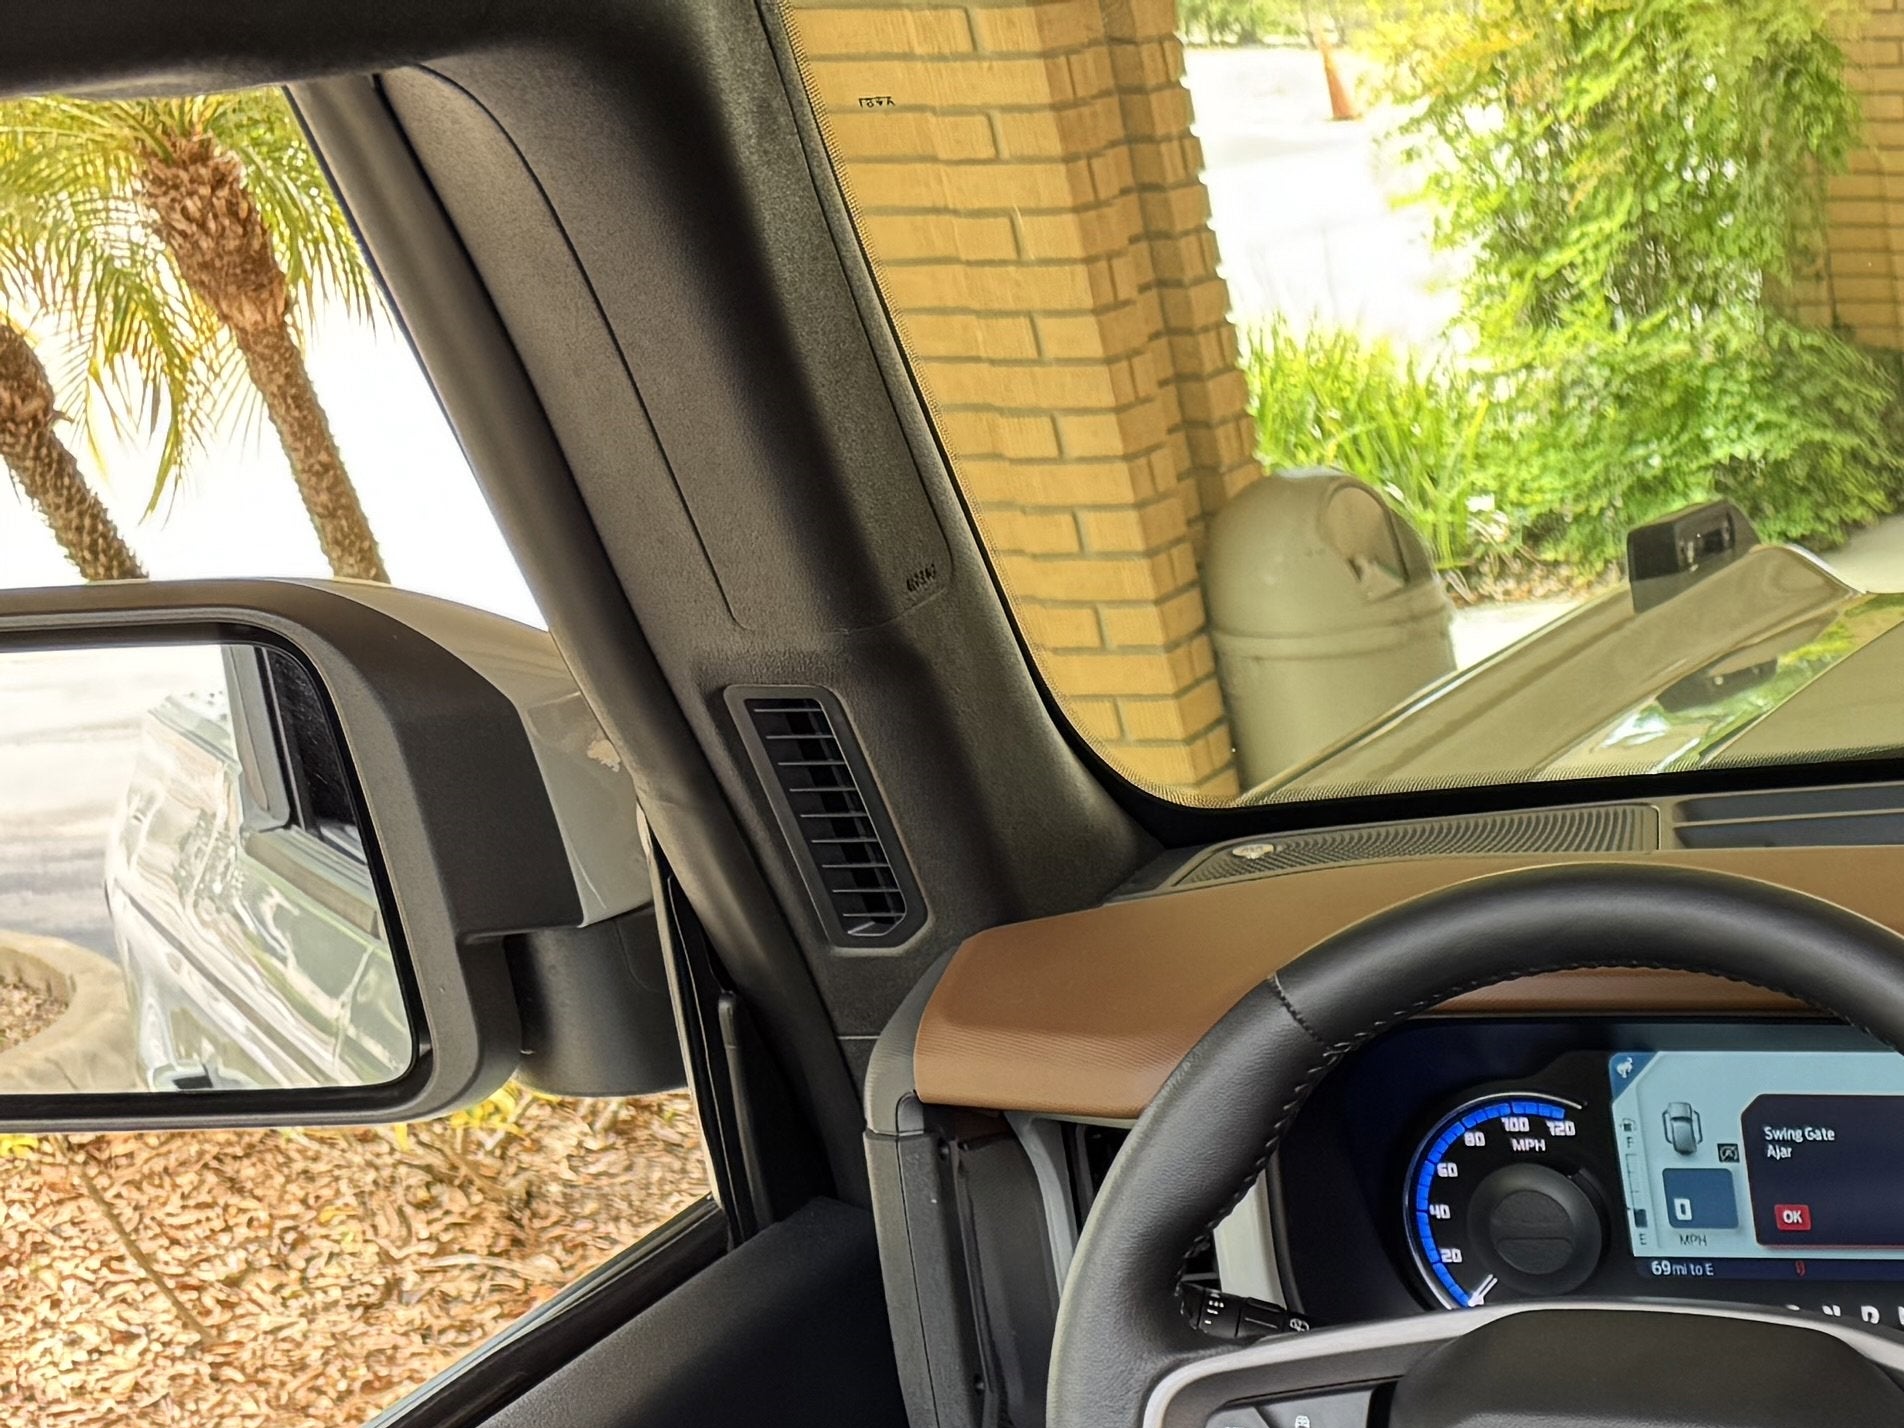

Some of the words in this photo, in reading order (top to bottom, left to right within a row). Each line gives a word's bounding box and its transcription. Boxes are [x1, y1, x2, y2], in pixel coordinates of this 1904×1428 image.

[1501, 1117, 1530, 1132] 100
[1546, 1120, 1576, 1136] 120
[1463, 1131, 1486, 1147] 80
[1764, 1126, 1803, 1143] Swing
[1804, 1127, 1836, 1141] Gate
[1511, 1138, 1546, 1152] MPH
[1767, 1145, 1792, 1160] Ajar
[1436, 1162, 1459, 1178] 60
[1429, 1203, 1451, 1219] 40
[1782, 1209, 1803, 1224] OK
[1639, 1232, 1647, 1246] E
[1680, 1234, 1708, 1247] MPH
[1440, 1248, 1463, 1264] 20
[1689, 1263, 1703, 1276] to
[1704, 1262, 1715, 1276] E
